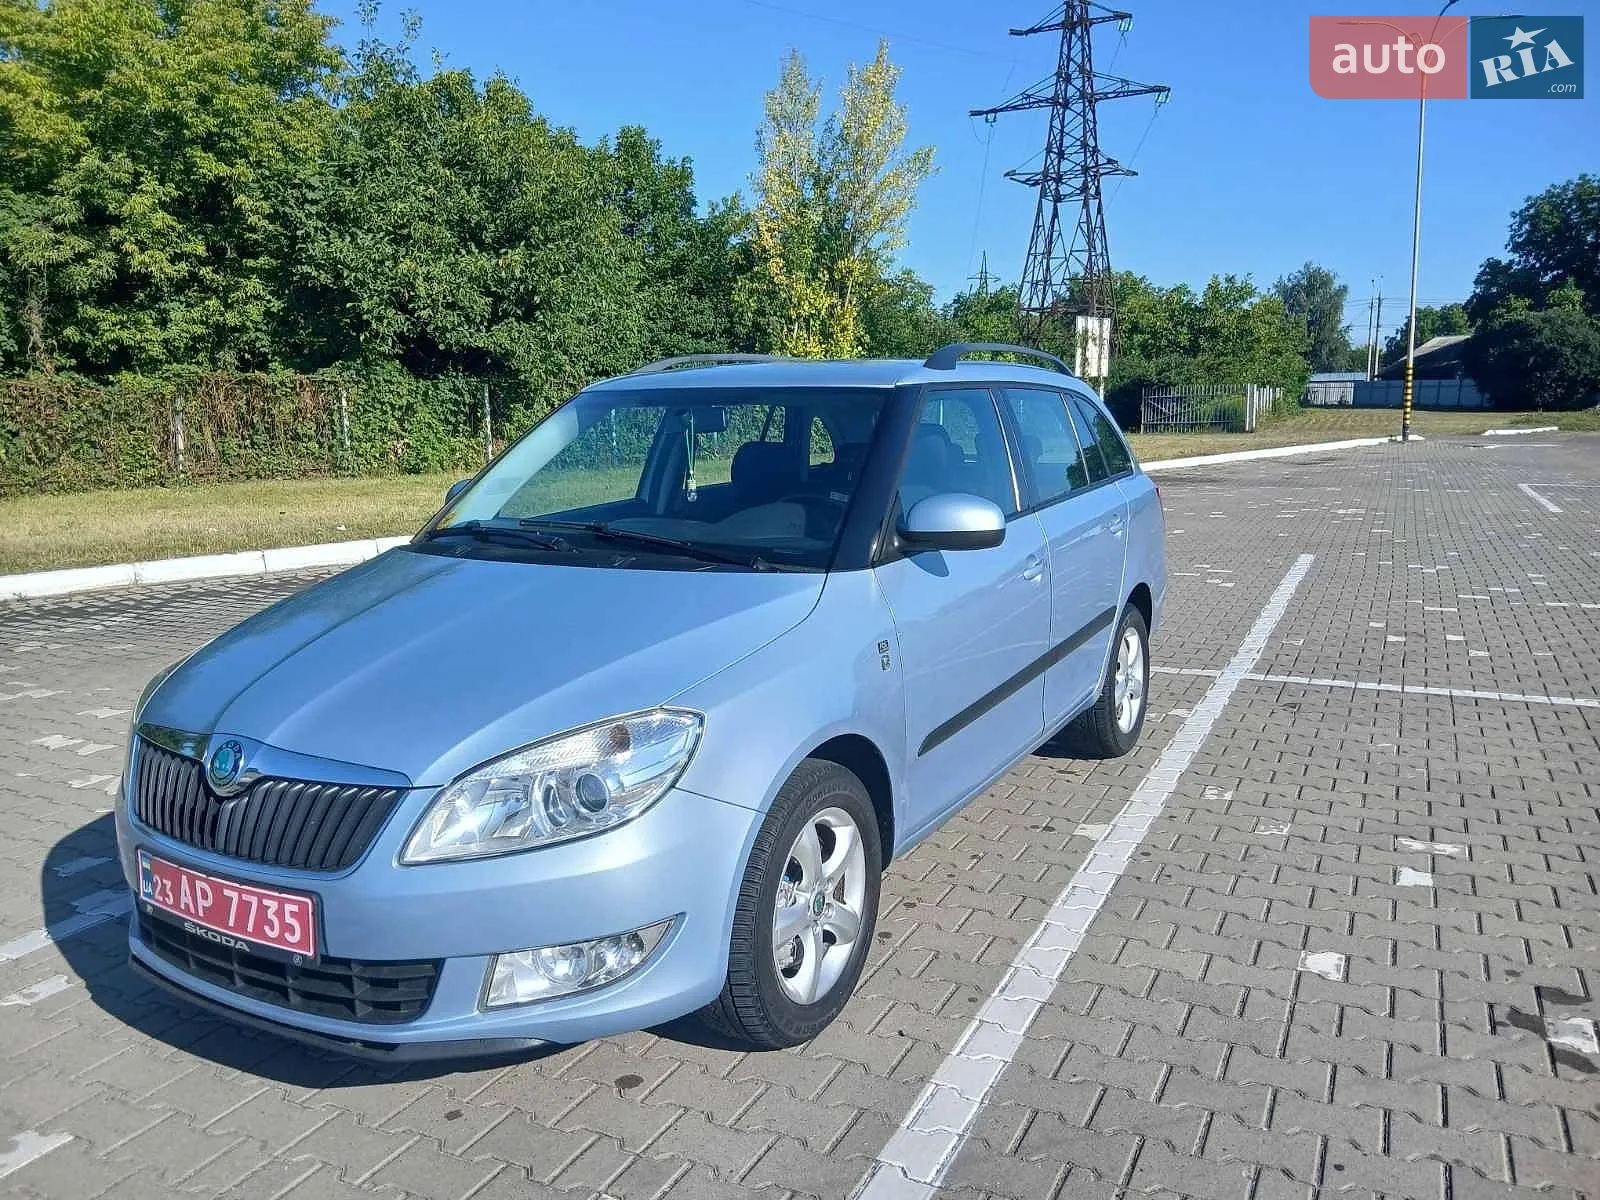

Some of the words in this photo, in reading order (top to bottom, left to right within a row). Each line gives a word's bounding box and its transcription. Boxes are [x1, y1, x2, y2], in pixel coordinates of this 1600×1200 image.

[153, 874, 174, 905] 23
[180, 875, 213, 917] AP
[223, 889, 301, 944] 7735
